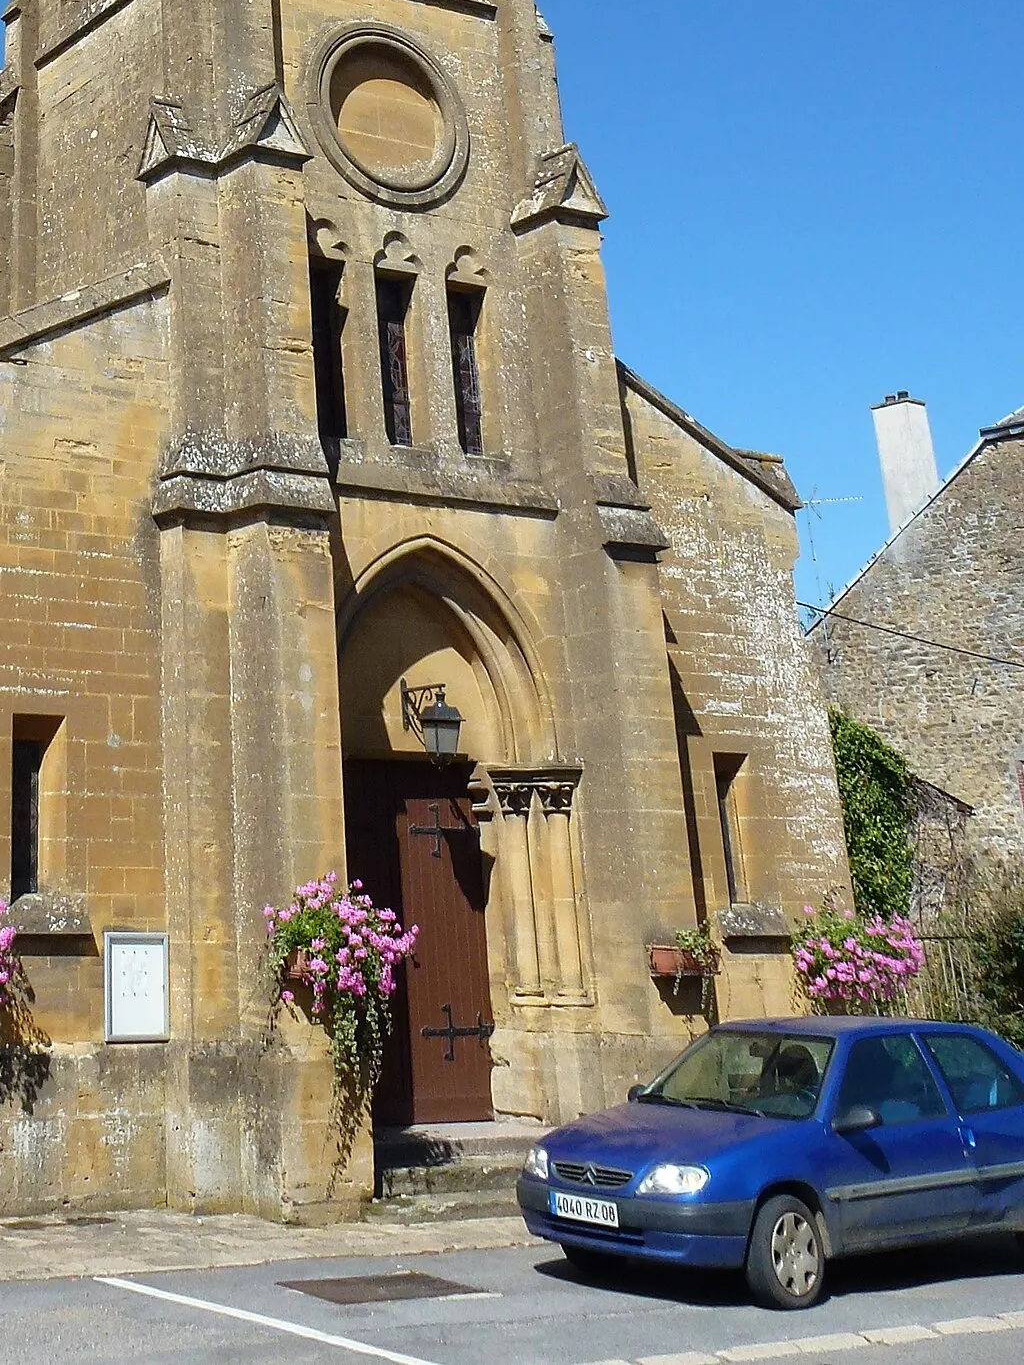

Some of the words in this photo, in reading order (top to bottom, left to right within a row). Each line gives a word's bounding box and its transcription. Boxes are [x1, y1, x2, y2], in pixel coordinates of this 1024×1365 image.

[557, 1196, 582, 1216] 4040
[585, 1201, 600, 1219] RZ
[601, 1205, 616, 1222] 08
